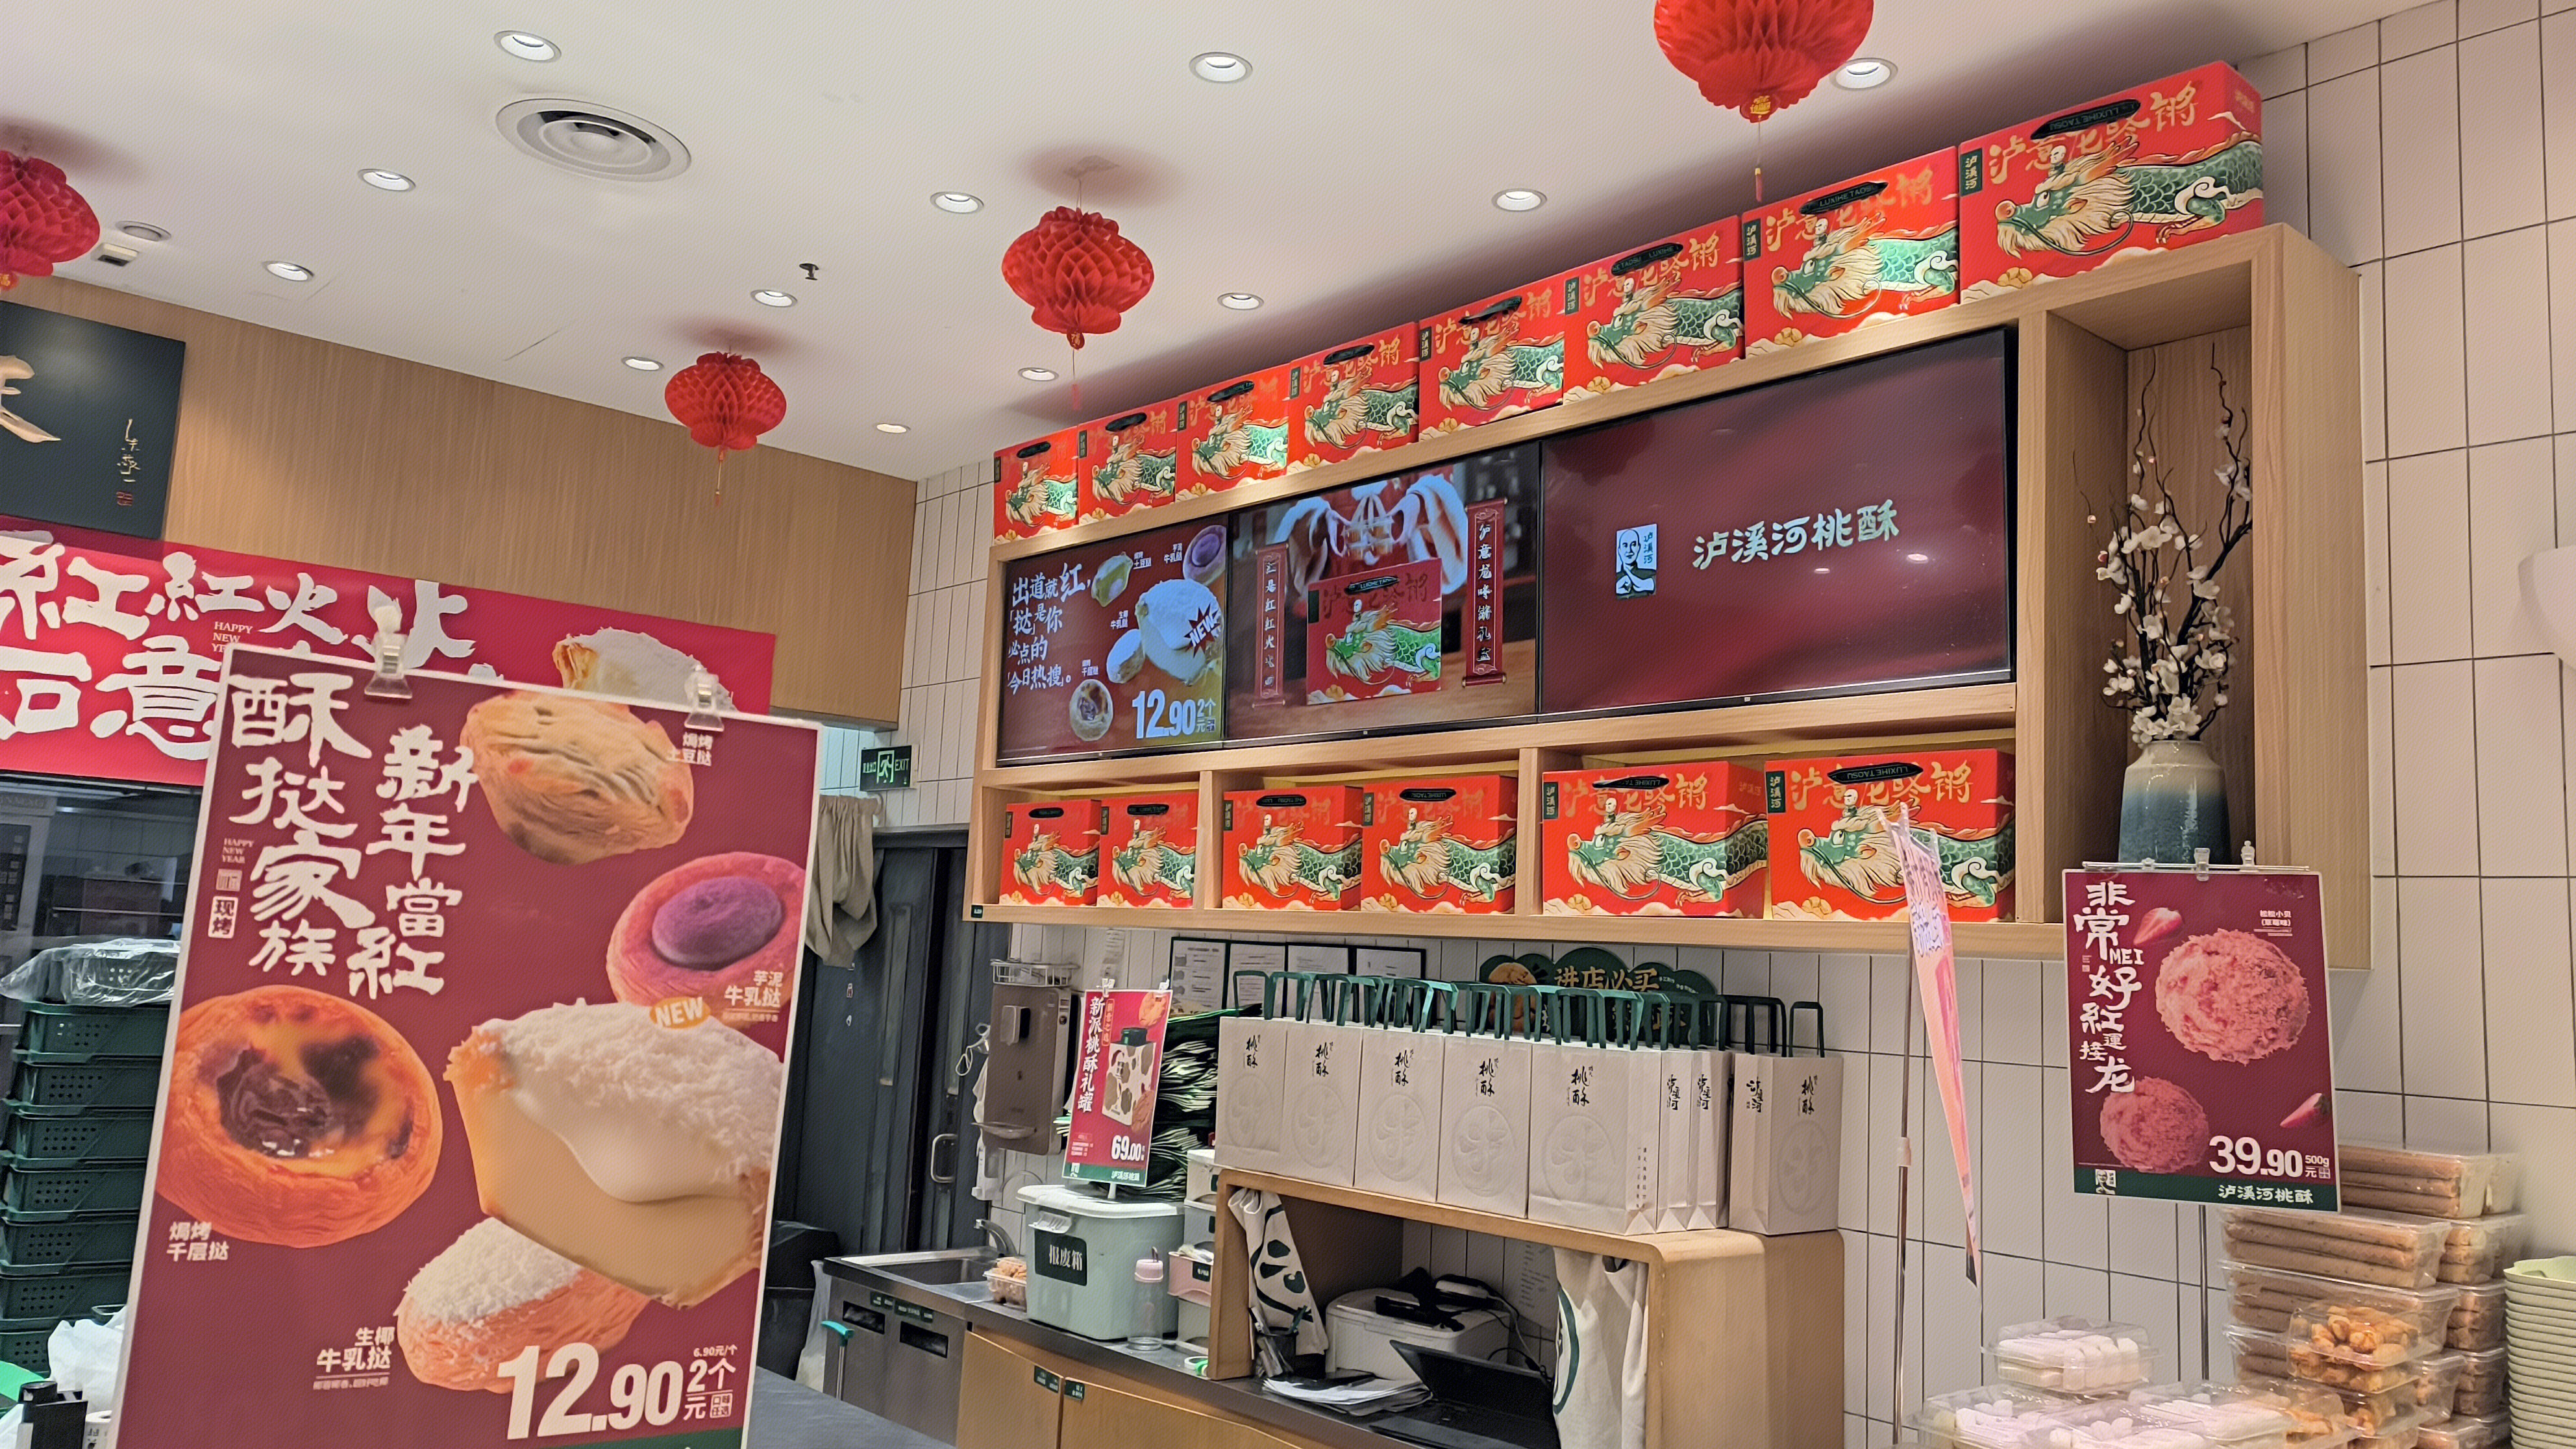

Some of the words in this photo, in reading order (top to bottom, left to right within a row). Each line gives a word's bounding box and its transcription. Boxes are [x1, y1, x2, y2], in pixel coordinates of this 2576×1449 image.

[1692, 499, 1900, 570] 泸溪河桃酥
[1011, 562, 1092, 607] 出道就红，
[212, 632, 241, 643] NEW
[214, 621, 253, 634] HAPPY
[1190, 609, 1220, 648] NEW
[1008, 636, 1048, 665] 必点的
[1132, 689, 1196, 739] 12.90
[895, 758, 910, 771] EXIT
[227, 671, 376, 976] 酥挞家族
[346, 723, 479, 1000] 新年當紅
[752, 969, 784, 987] 芋泥
[1554, 965, 1660, 993] 进店必买
[723, 984, 782, 1008] 牛乳挞
[654, 996, 704, 1028] NEW
[1077, 996, 1106, 1113] 新派桃酥礼罐
[1111, 1135, 1142, 1161] 69.00
[2209, 1135, 2303, 1178] 39.90
[2305, 1154, 2330, 1167] 500g
[2305, 1167, 2318, 1178] 元
[2218, 1184, 2314, 1204] 泸溪河桃酥
[169, 1221, 212, 1242] 焗烤
[166, 1241, 229, 1262] 千层挞
[354, 1326, 395, 1346] 生椰
[316, 1345, 392, 1373] 牛乳挞
[693, 1344, 738, 1357] 6.90元/个
[687, 1357, 736, 1393] 2个
[497, 1341, 684, 1441] 12.90
[683, 1396, 706, 1421] 元
